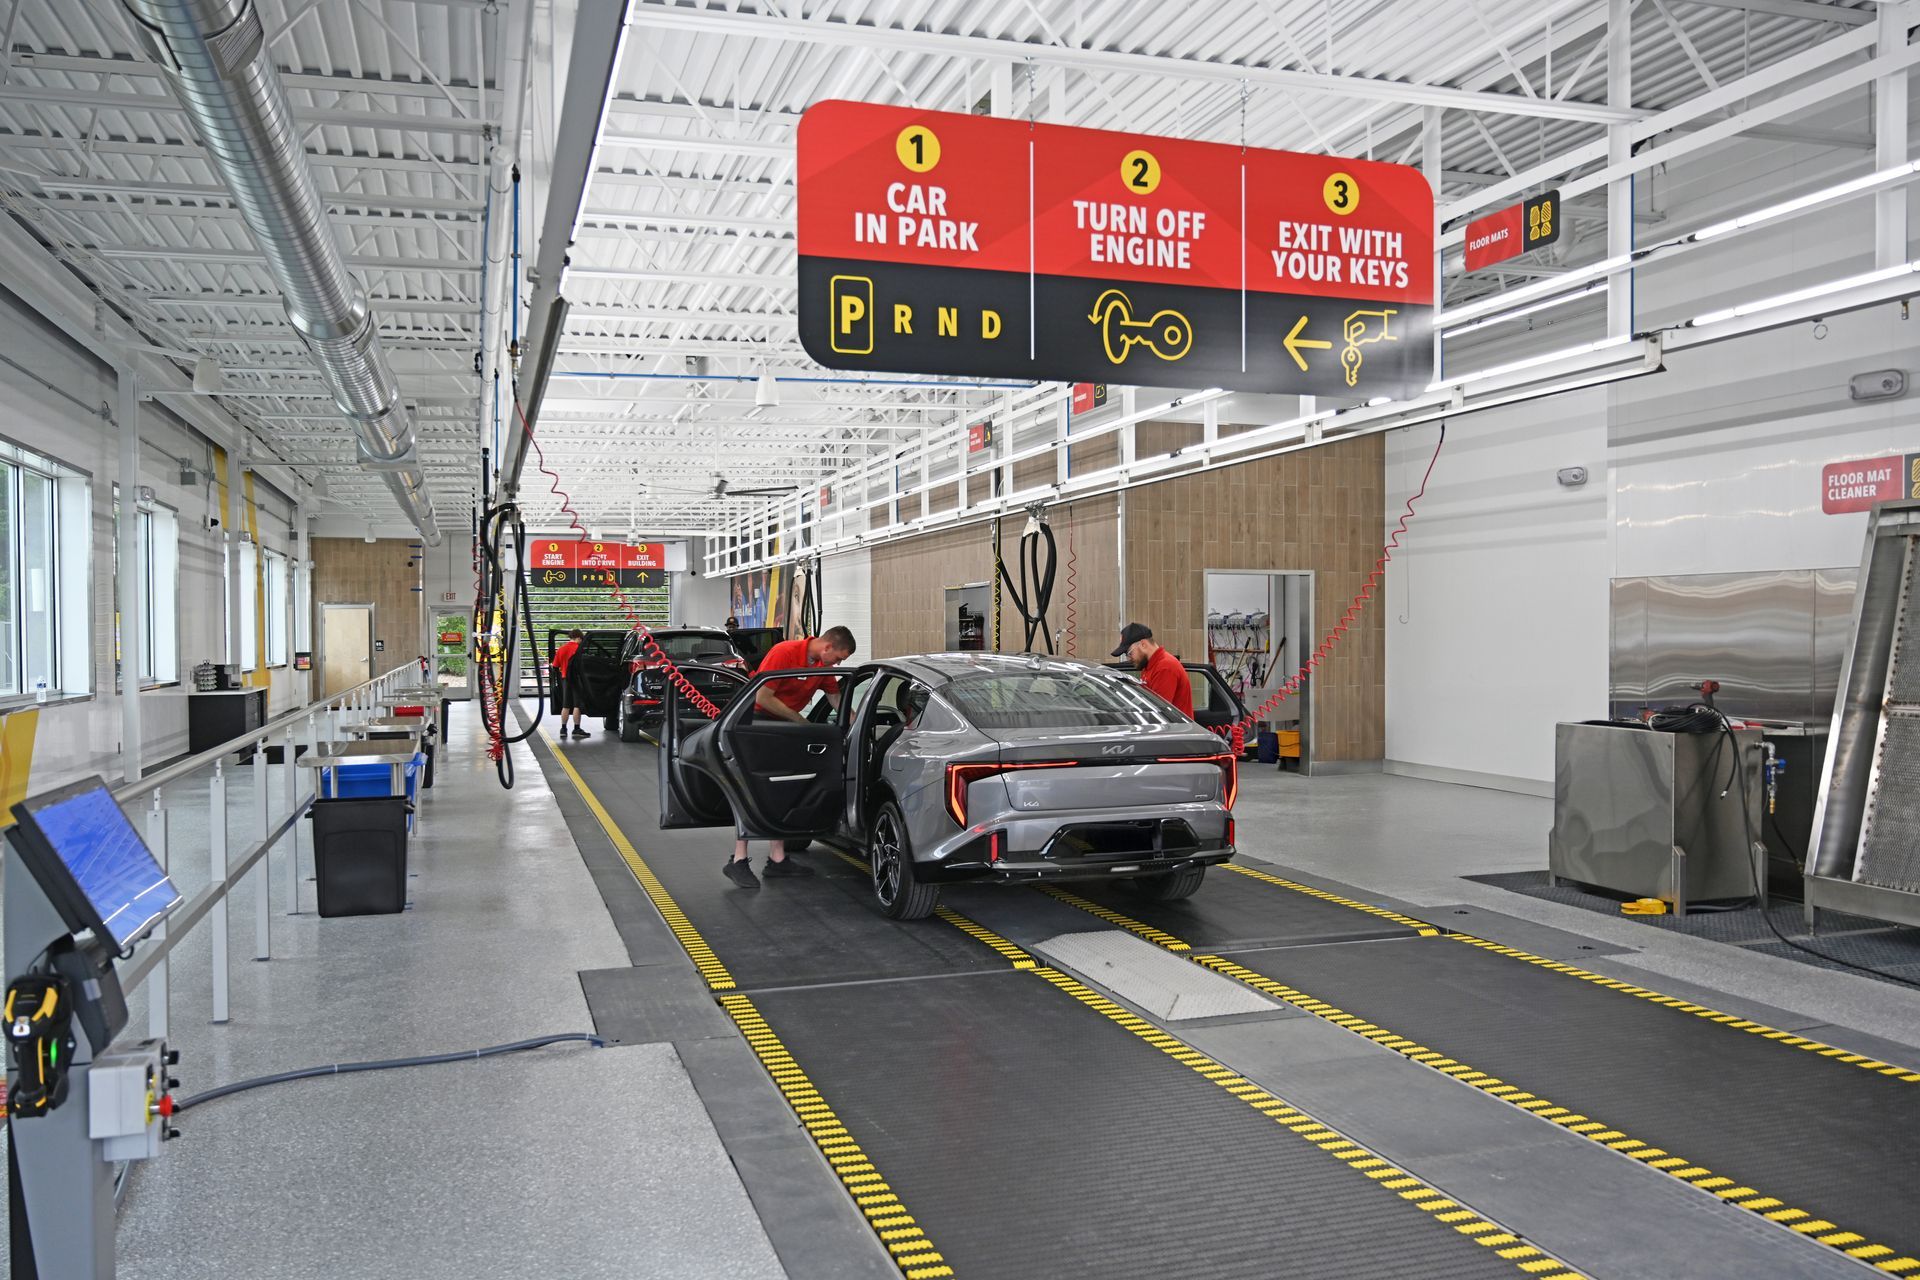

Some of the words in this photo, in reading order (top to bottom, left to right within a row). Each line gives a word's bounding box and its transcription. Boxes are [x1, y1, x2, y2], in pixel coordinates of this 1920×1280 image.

[909, 134, 923, 165] 1
[1132, 157, 1149, 188] 2
[887, 182, 947, 216] CAR
[1333, 180, 1349, 208] 3
[855, 212, 887, 244] IN
[898, 216, 979, 252] PARK
[1073, 200, 1147, 235] TURN
[1156, 208, 1206, 240] OFF
[1090, 233, 1191, 270] ENGINE
[1279, 220, 1332, 252] EXIT
[1338, 226, 1402, 259] WITH
[1469, 235, 1491, 252] FLOOR
[1491, 228, 1509, 243] MATS
[1271, 250, 1342, 283] YOUR
[1349, 257, 1409, 289] KEYS
[841, 295, 865, 334] P
[894, 303, 913, 334] R
[938, 306, 958, 337] N
[982, 310, 1002, 339] D
[1828, 472, 1864, 487] FLOOR
[1866, 468, 1892, 483] MAT
[1828, 485, 1877, 501] CLEANER
[445, 592, 456, 601] EXIT
